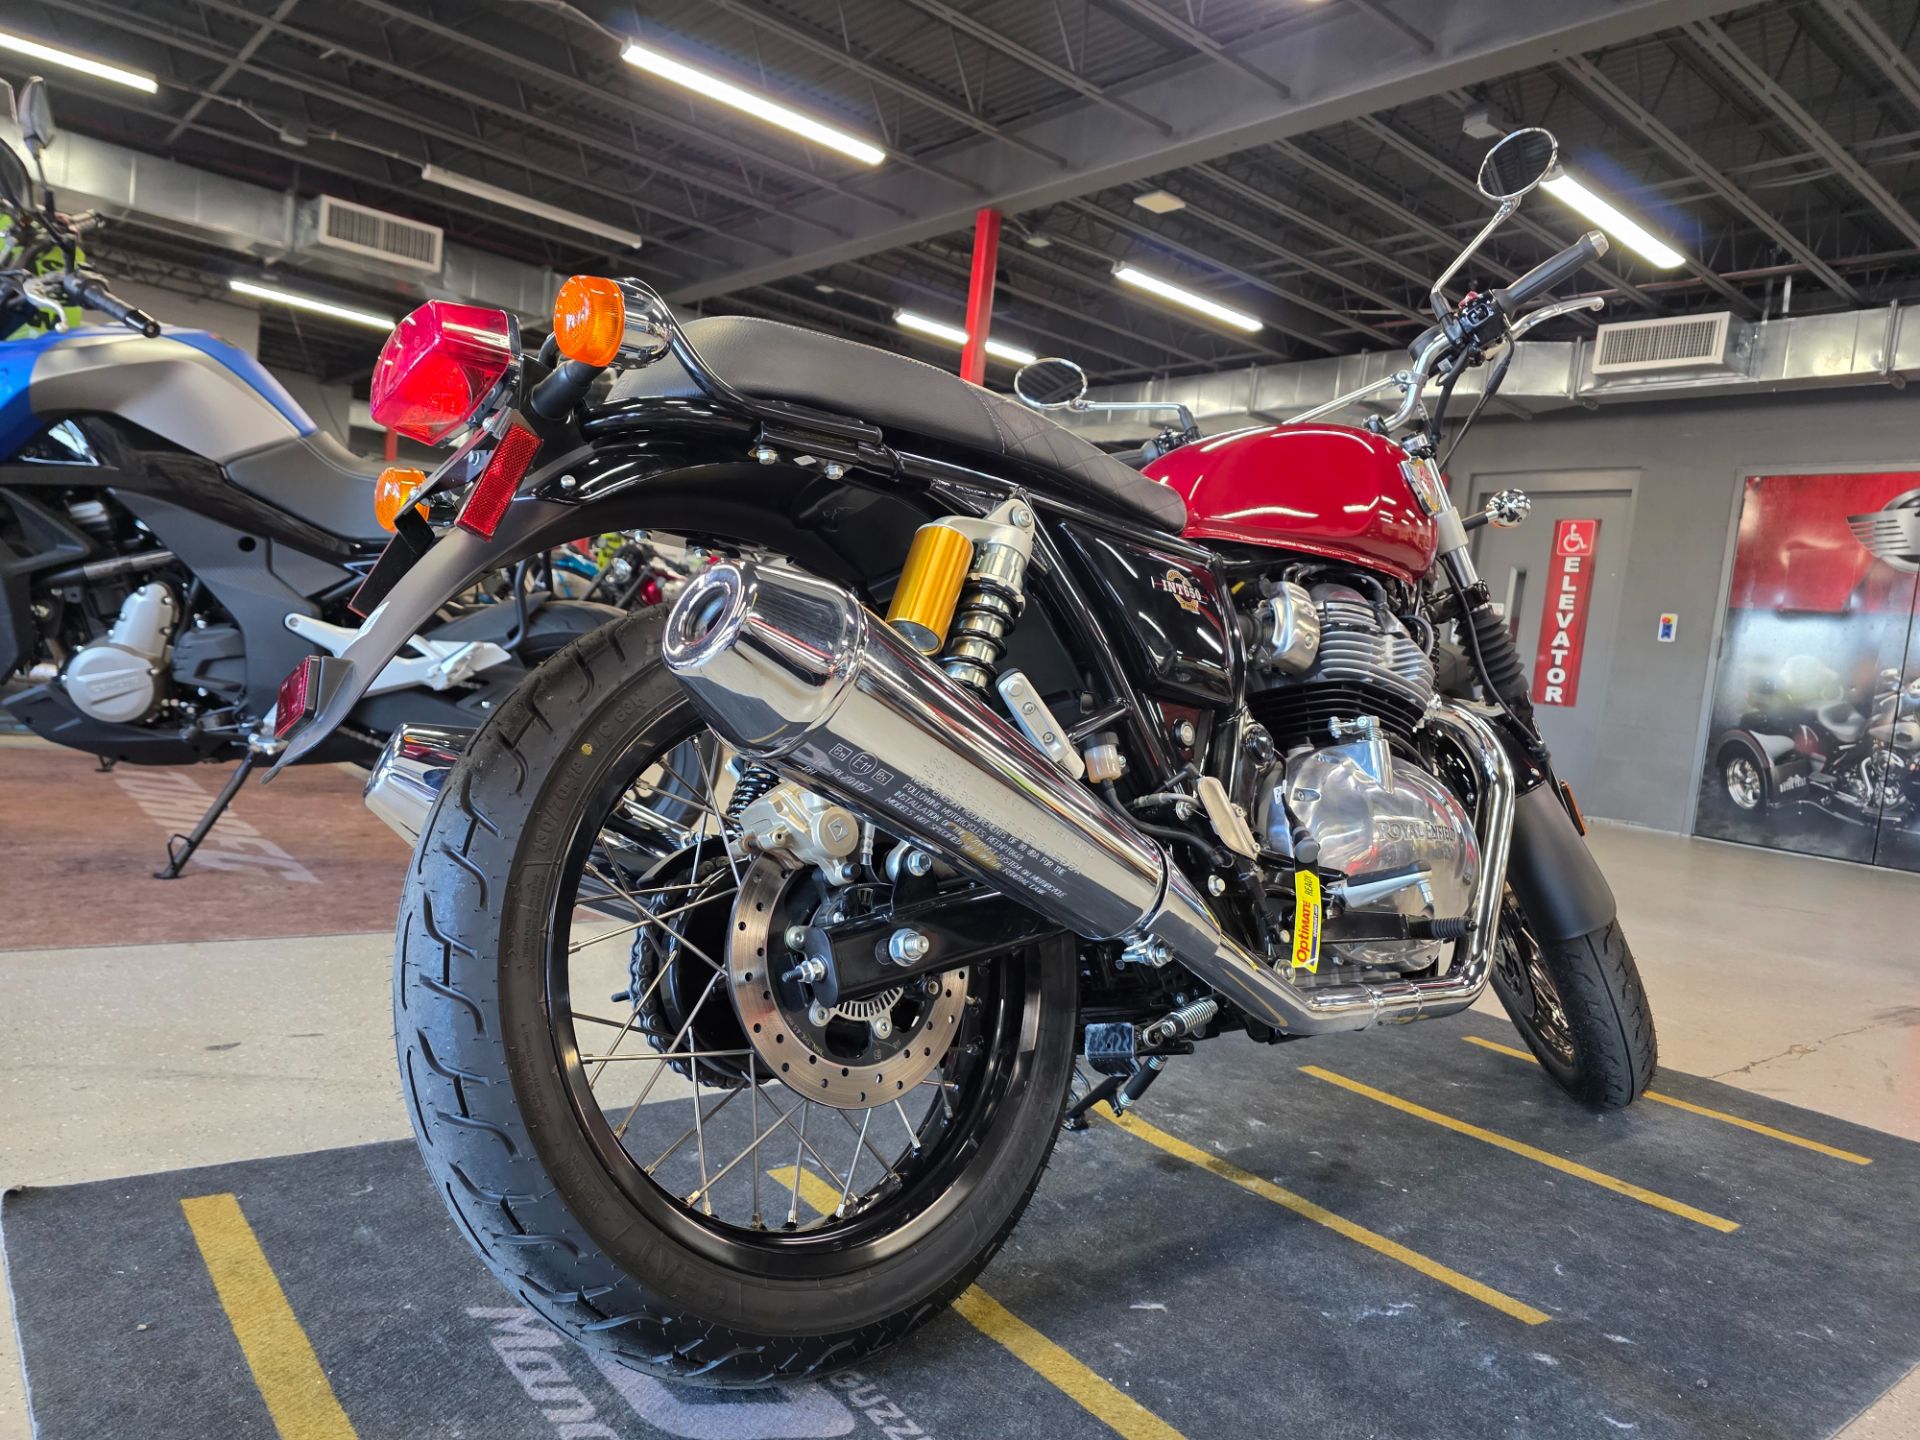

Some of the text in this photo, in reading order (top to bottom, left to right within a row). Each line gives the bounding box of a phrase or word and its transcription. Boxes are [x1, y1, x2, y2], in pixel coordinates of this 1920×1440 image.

[1161, 579, 1202, 601] INT650
[1545, 556, 1581, 703] ELEVATOR
[903, 783, 942, 809] FOLLOWING
[1376, 821, 1457, 842] ROYAL ENFIELD
[1304, 873, 1314, 897] READY
